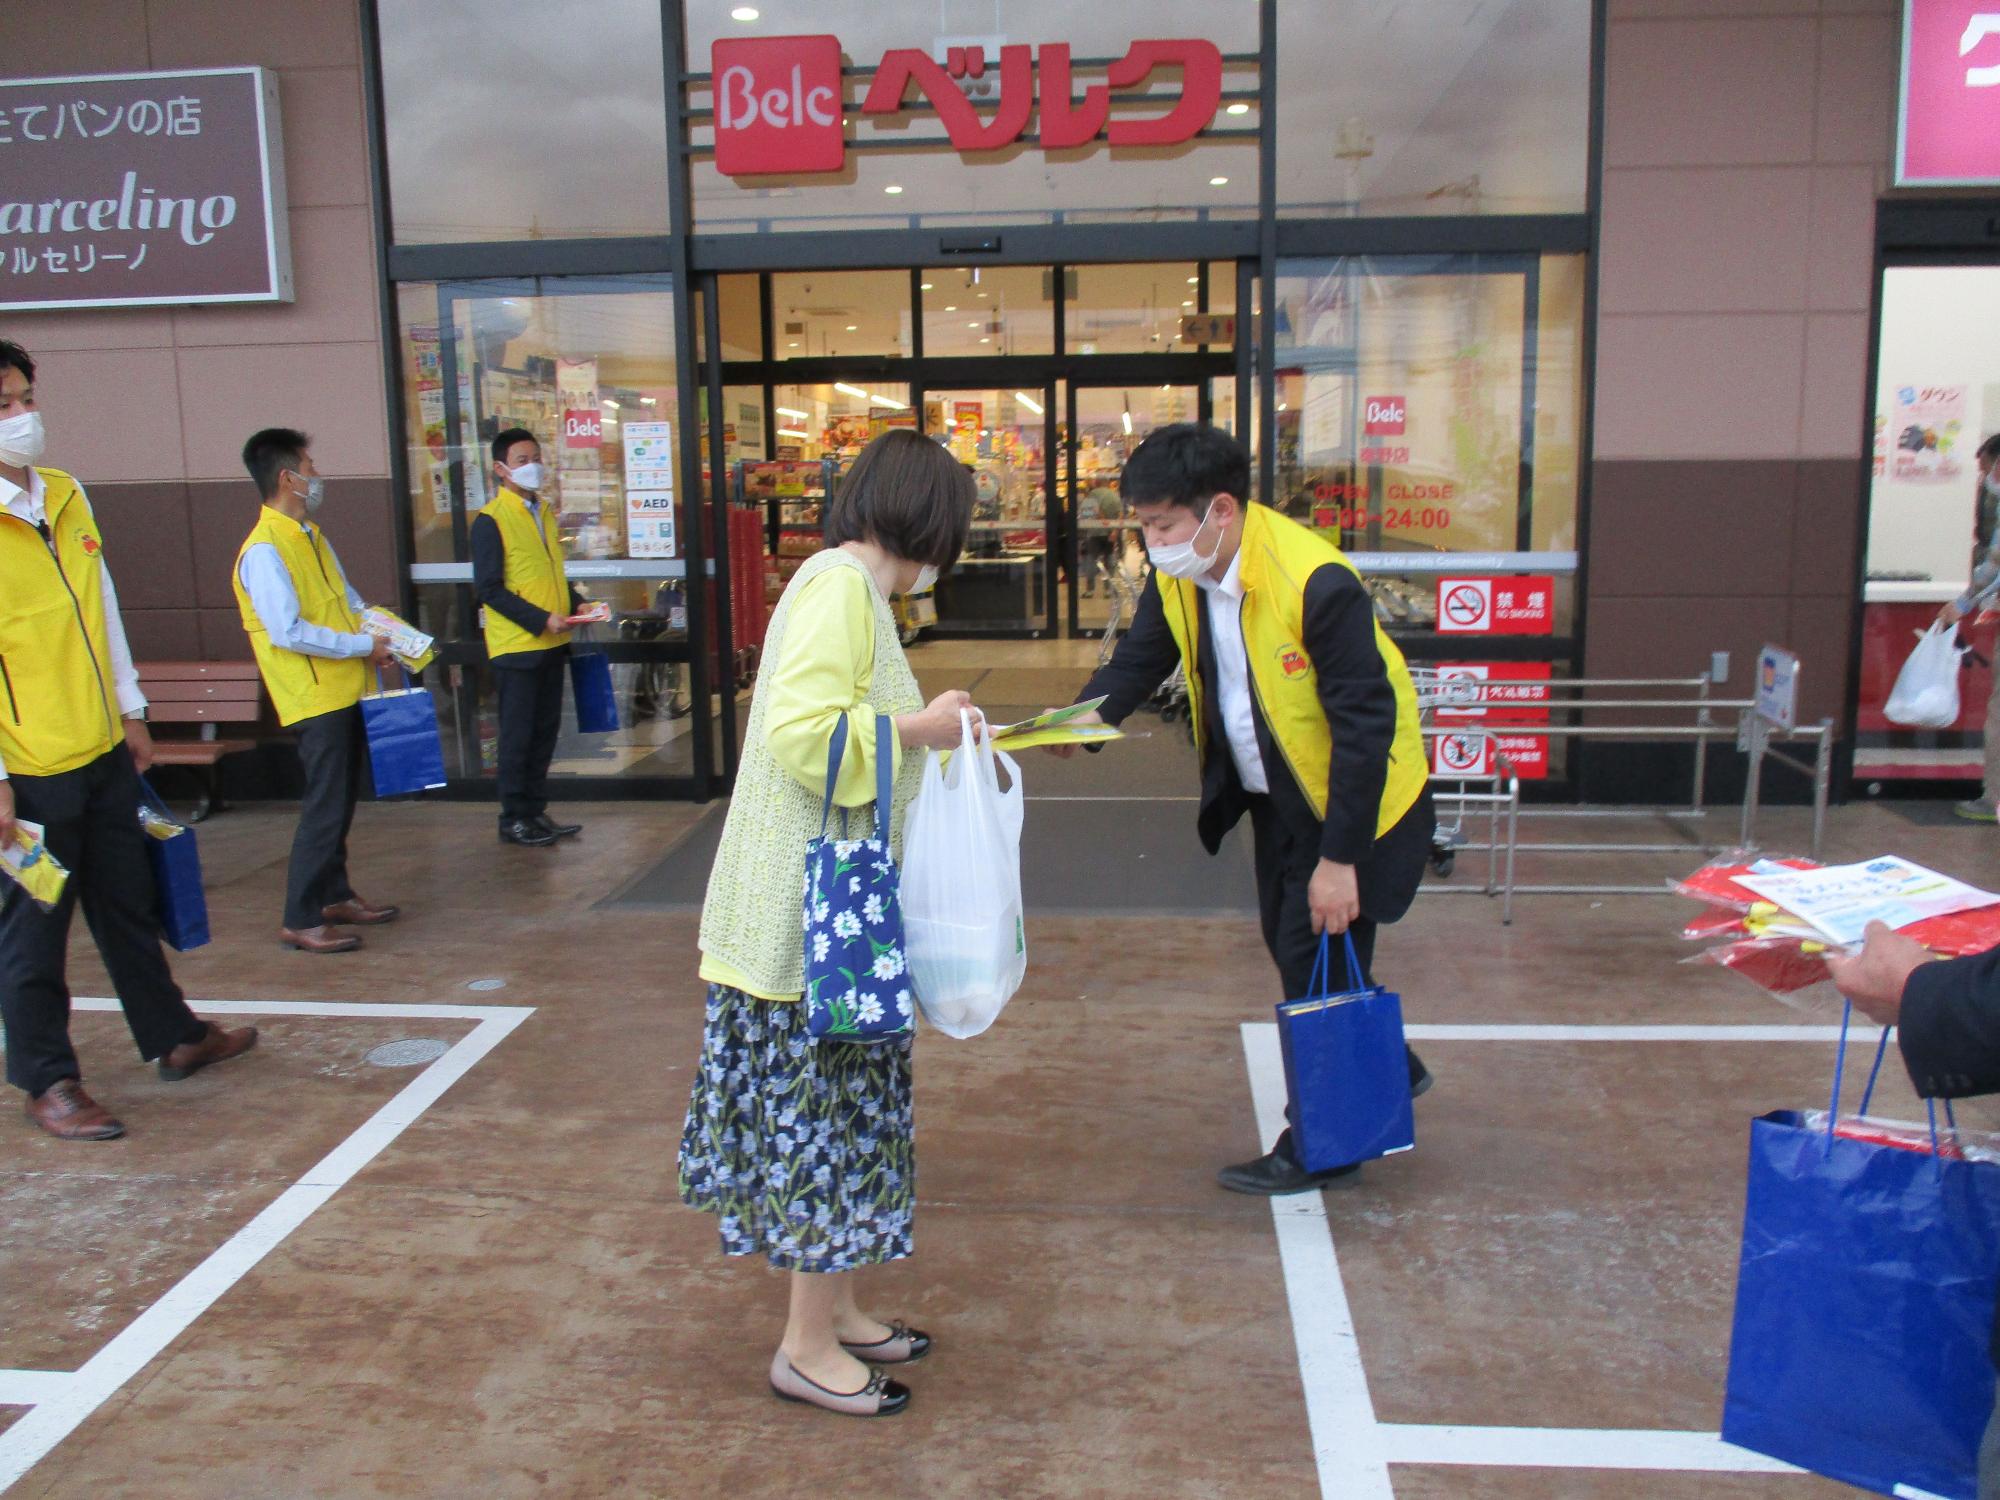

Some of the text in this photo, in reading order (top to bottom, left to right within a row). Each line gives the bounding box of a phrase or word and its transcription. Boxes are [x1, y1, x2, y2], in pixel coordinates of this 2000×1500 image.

[719, 64, 836, 131] Belc
[862, 38, 1223, 150] ベルク
[0, 244, 147, 274] ルセリーノ
[1367, 402, 1404, 424] Belc
[566, 418, 601, 437] Belc
[1314, 484, 1454, 500] OPEN CLOSE
[643, 498, 669, 509] AED
